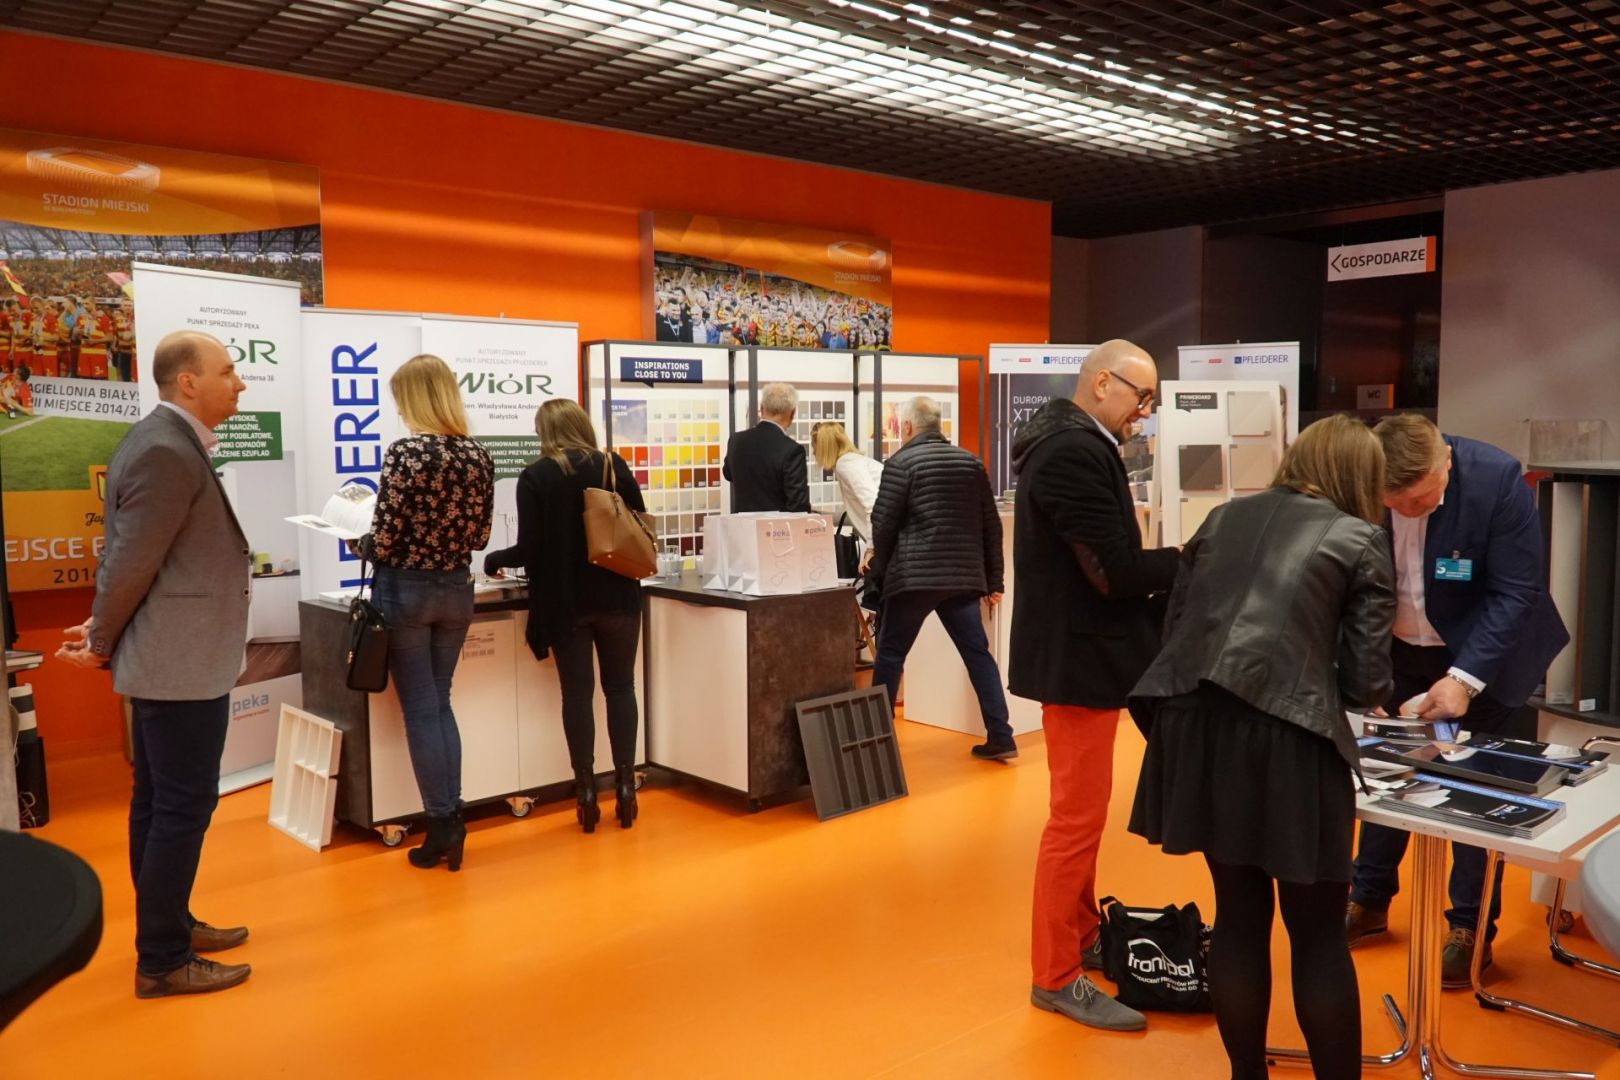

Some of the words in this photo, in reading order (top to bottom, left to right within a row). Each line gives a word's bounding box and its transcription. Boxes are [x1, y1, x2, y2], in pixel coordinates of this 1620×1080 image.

[42, 193, 99, 208] STADION
[102, 199, 149, 213] MIEJSKI
[1341, 248, 1426, 269] GOSPODARZE
[199, 306, 247, 316] AUTORYZOWANY
[187, 318, 207, 326] PUNKT
[244, 322, 261, 330] PEKA
[634, 361, 690, 371] INSPIRATIONS
[1242, 354, 1289, 365] PFLEIDERER
[634, 370, 659, 379] CLOSE
[660, 371, 671, 379] TO
[672, 371, 687, 379] YOU
[44, 398, 92, 413] MIEJSCE
[4, 537, 84, 563] EJSCE
[53, 568, 96, 584] 201
[232, 692, 270, 718] peka
